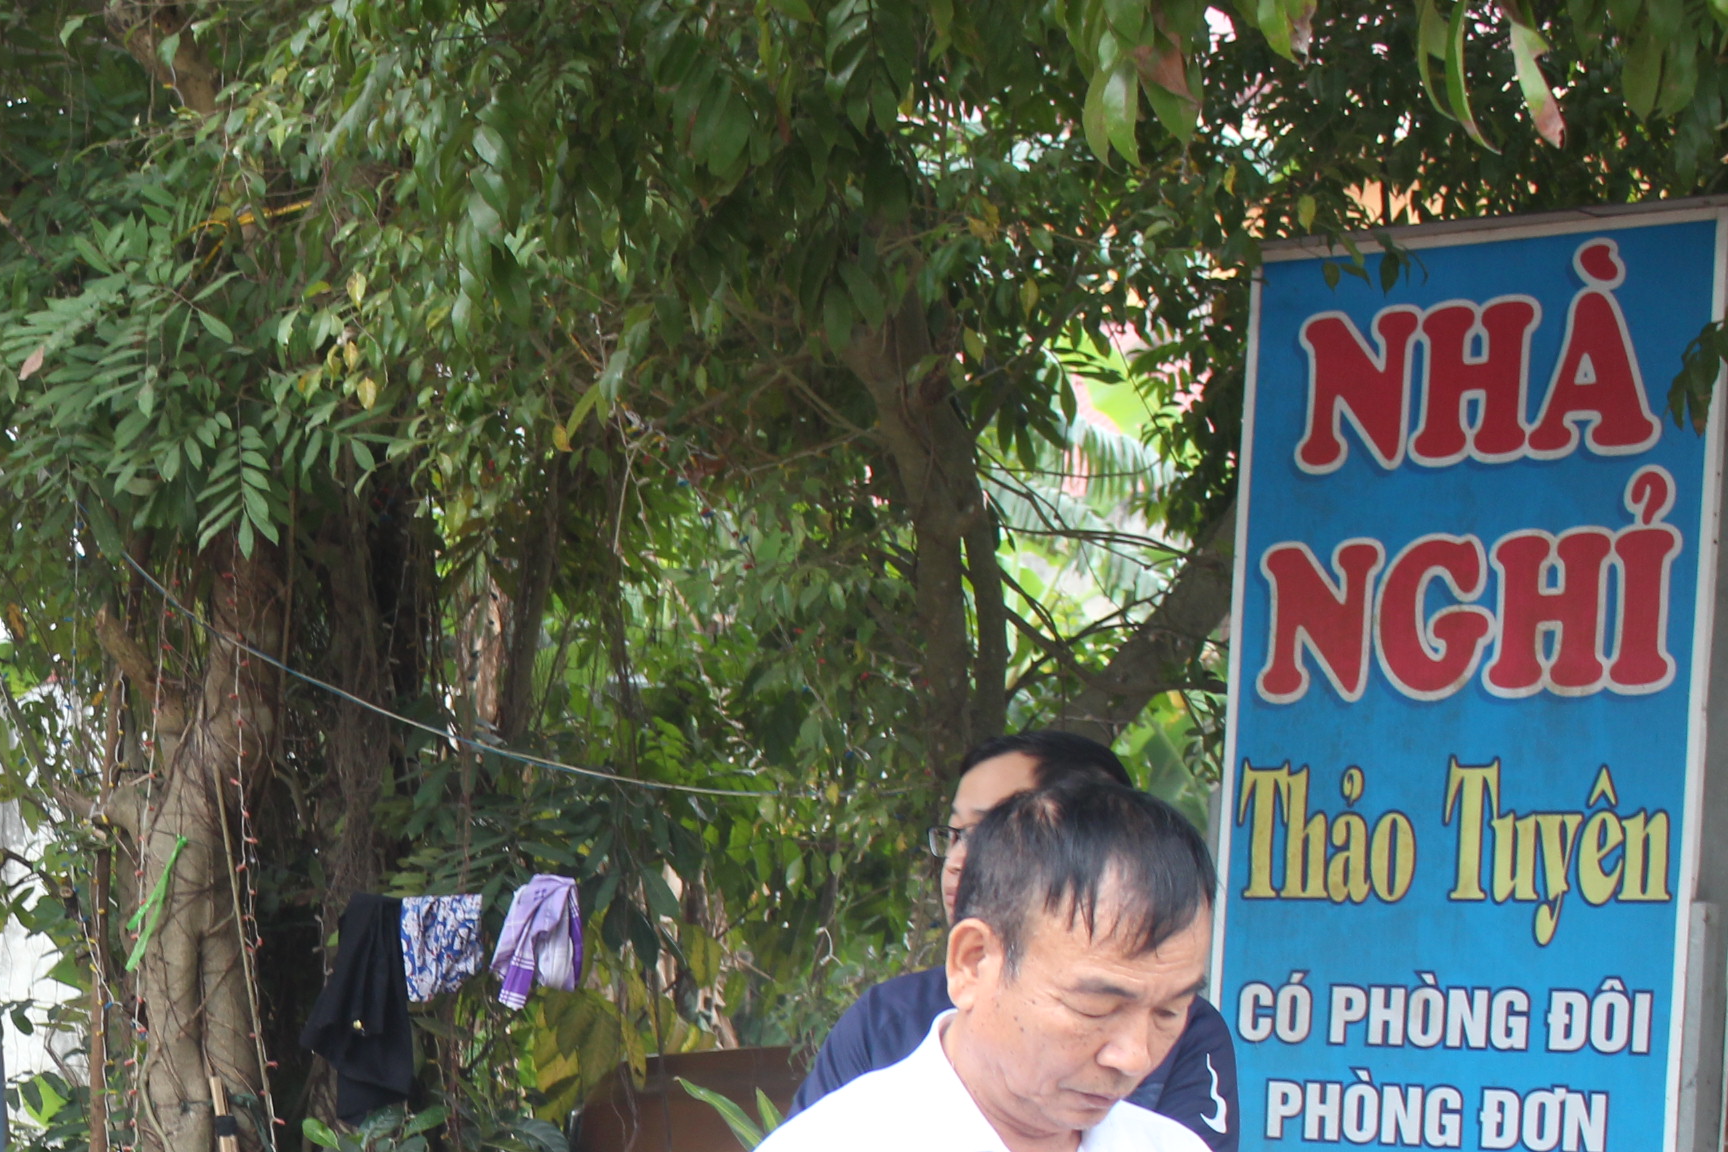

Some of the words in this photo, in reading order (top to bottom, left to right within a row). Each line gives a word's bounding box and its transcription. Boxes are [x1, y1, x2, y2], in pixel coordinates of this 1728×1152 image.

[1296, 237, 1661, 472] NHÀ
[1256, 463, 1683, 704] NGHỈ
[1236, 756, 1416, 903] Thảo
[1442, 753, 1671, 947] Tuyên
[1235, 970, 1312, 1043] CÓ
[1326, 970, 1531, 1053] PHÒNG
[1544, 975, 1655, 1056] ĐÔI
[1264, 1066, 1463, 1150] PHÒNG
